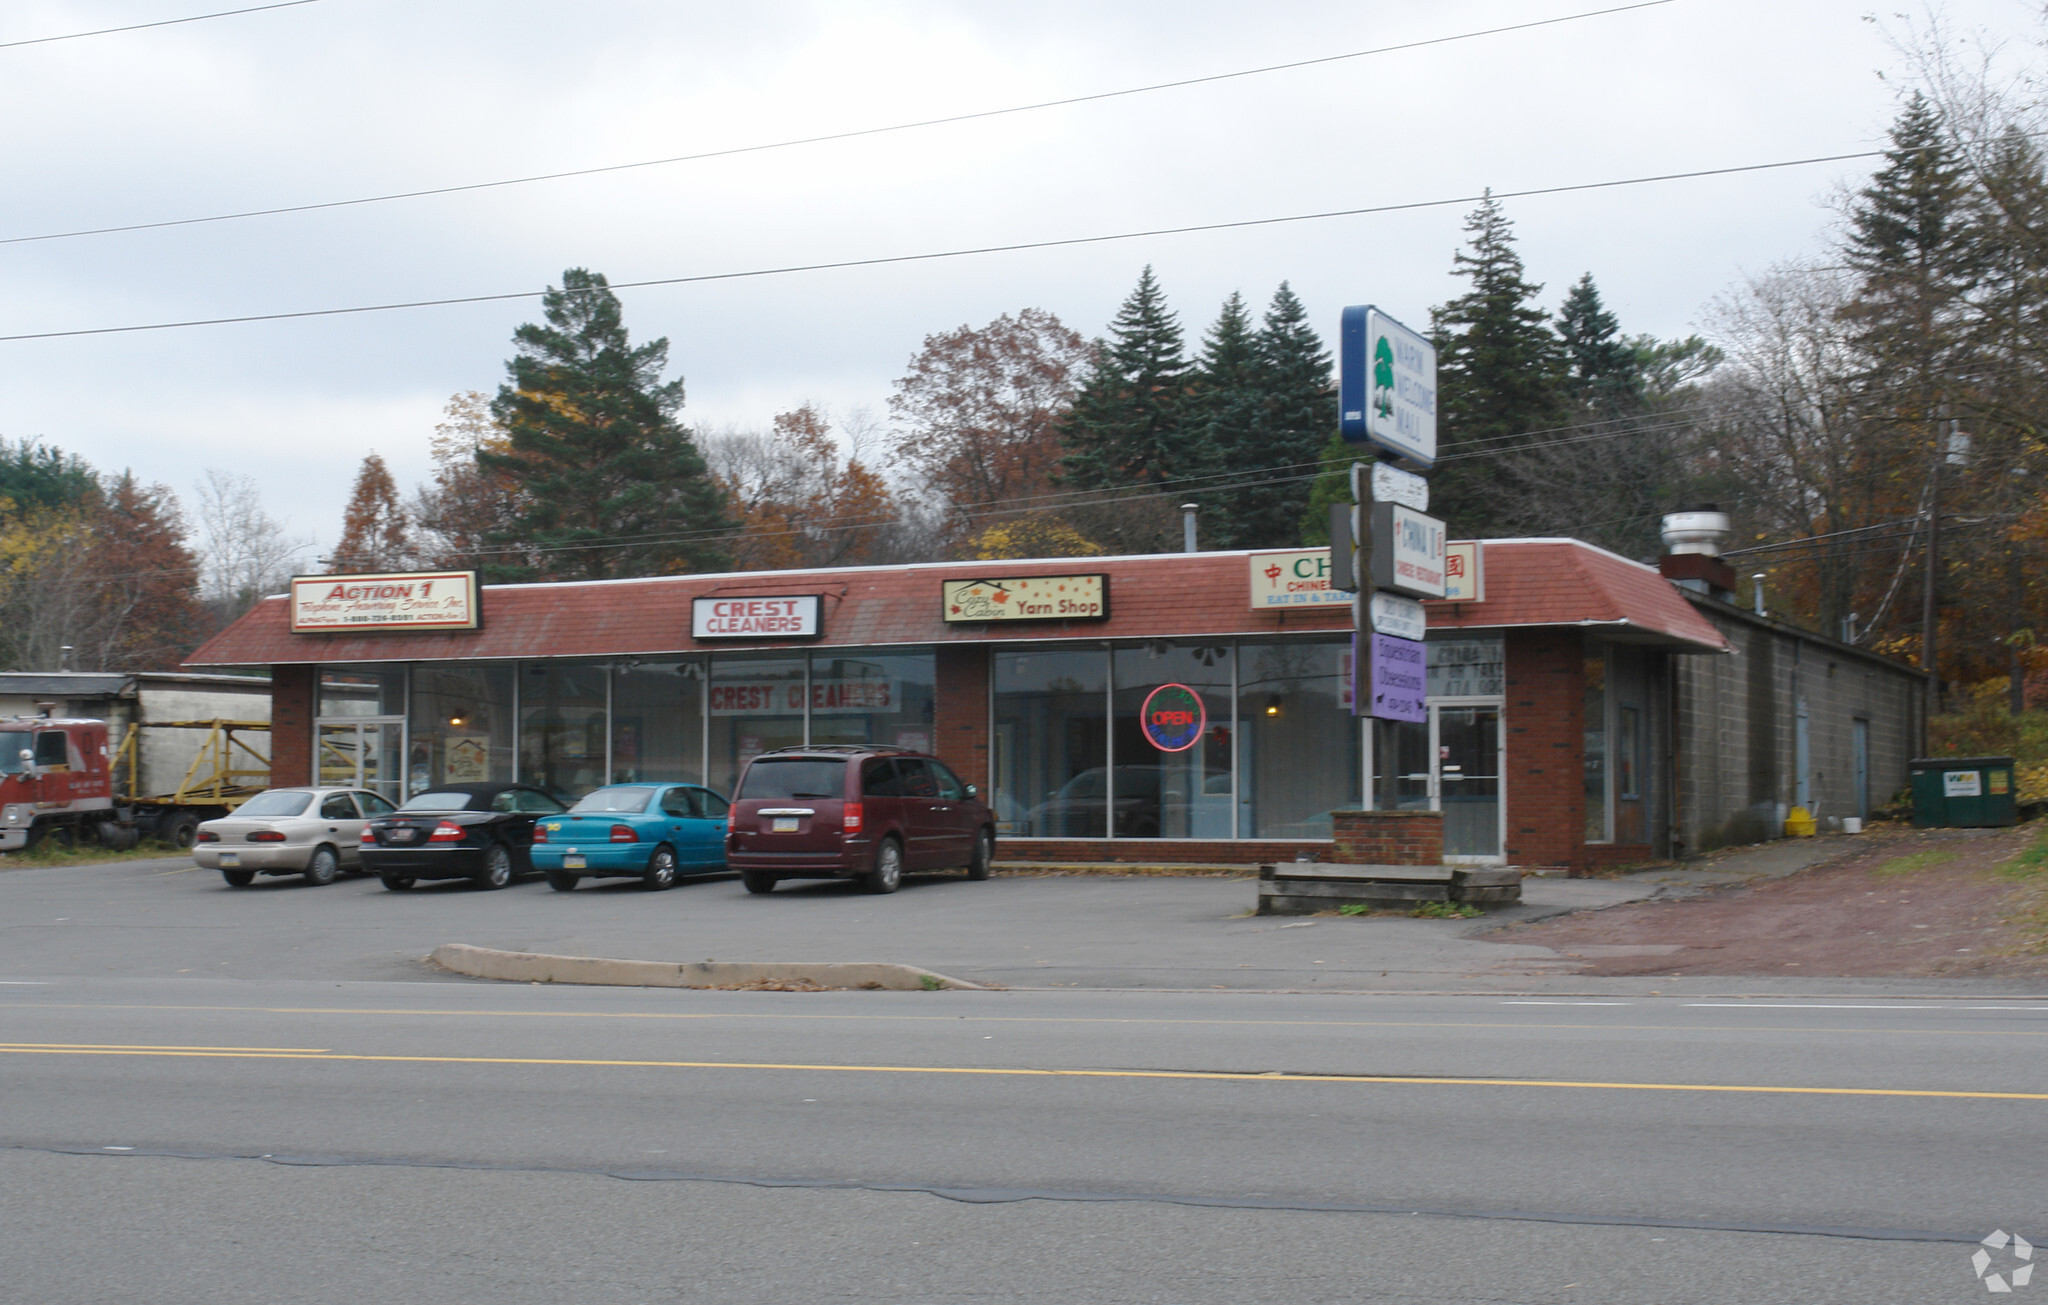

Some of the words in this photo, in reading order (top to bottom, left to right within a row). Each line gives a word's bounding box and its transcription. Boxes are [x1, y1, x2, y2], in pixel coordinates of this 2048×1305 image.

[1263, 563, 1283, 589] 中
[1293, 557, 1332, 578] CH
[325, 583, 415, 601] ACTION
[420, 581, 434, 600] 1
[1286, 580, 1332, 593] CHINE
[1267, 595, 1291, 605] EAT
[1293, 594, 1309, 604] IN
[713, 600, 798, 617] CREST
[963, 604, 1006, 618] Cabin
[1016, 601, 1053, 615] Yarn
[1059, 600, 1100, 616] Shop
[706, 616, 803, 633] CLEANERS
[711, 686, 775, 710] CREST
[787, 683, 891, 709] CEANERS
[1151, 710, 1194, 726] OPEN
